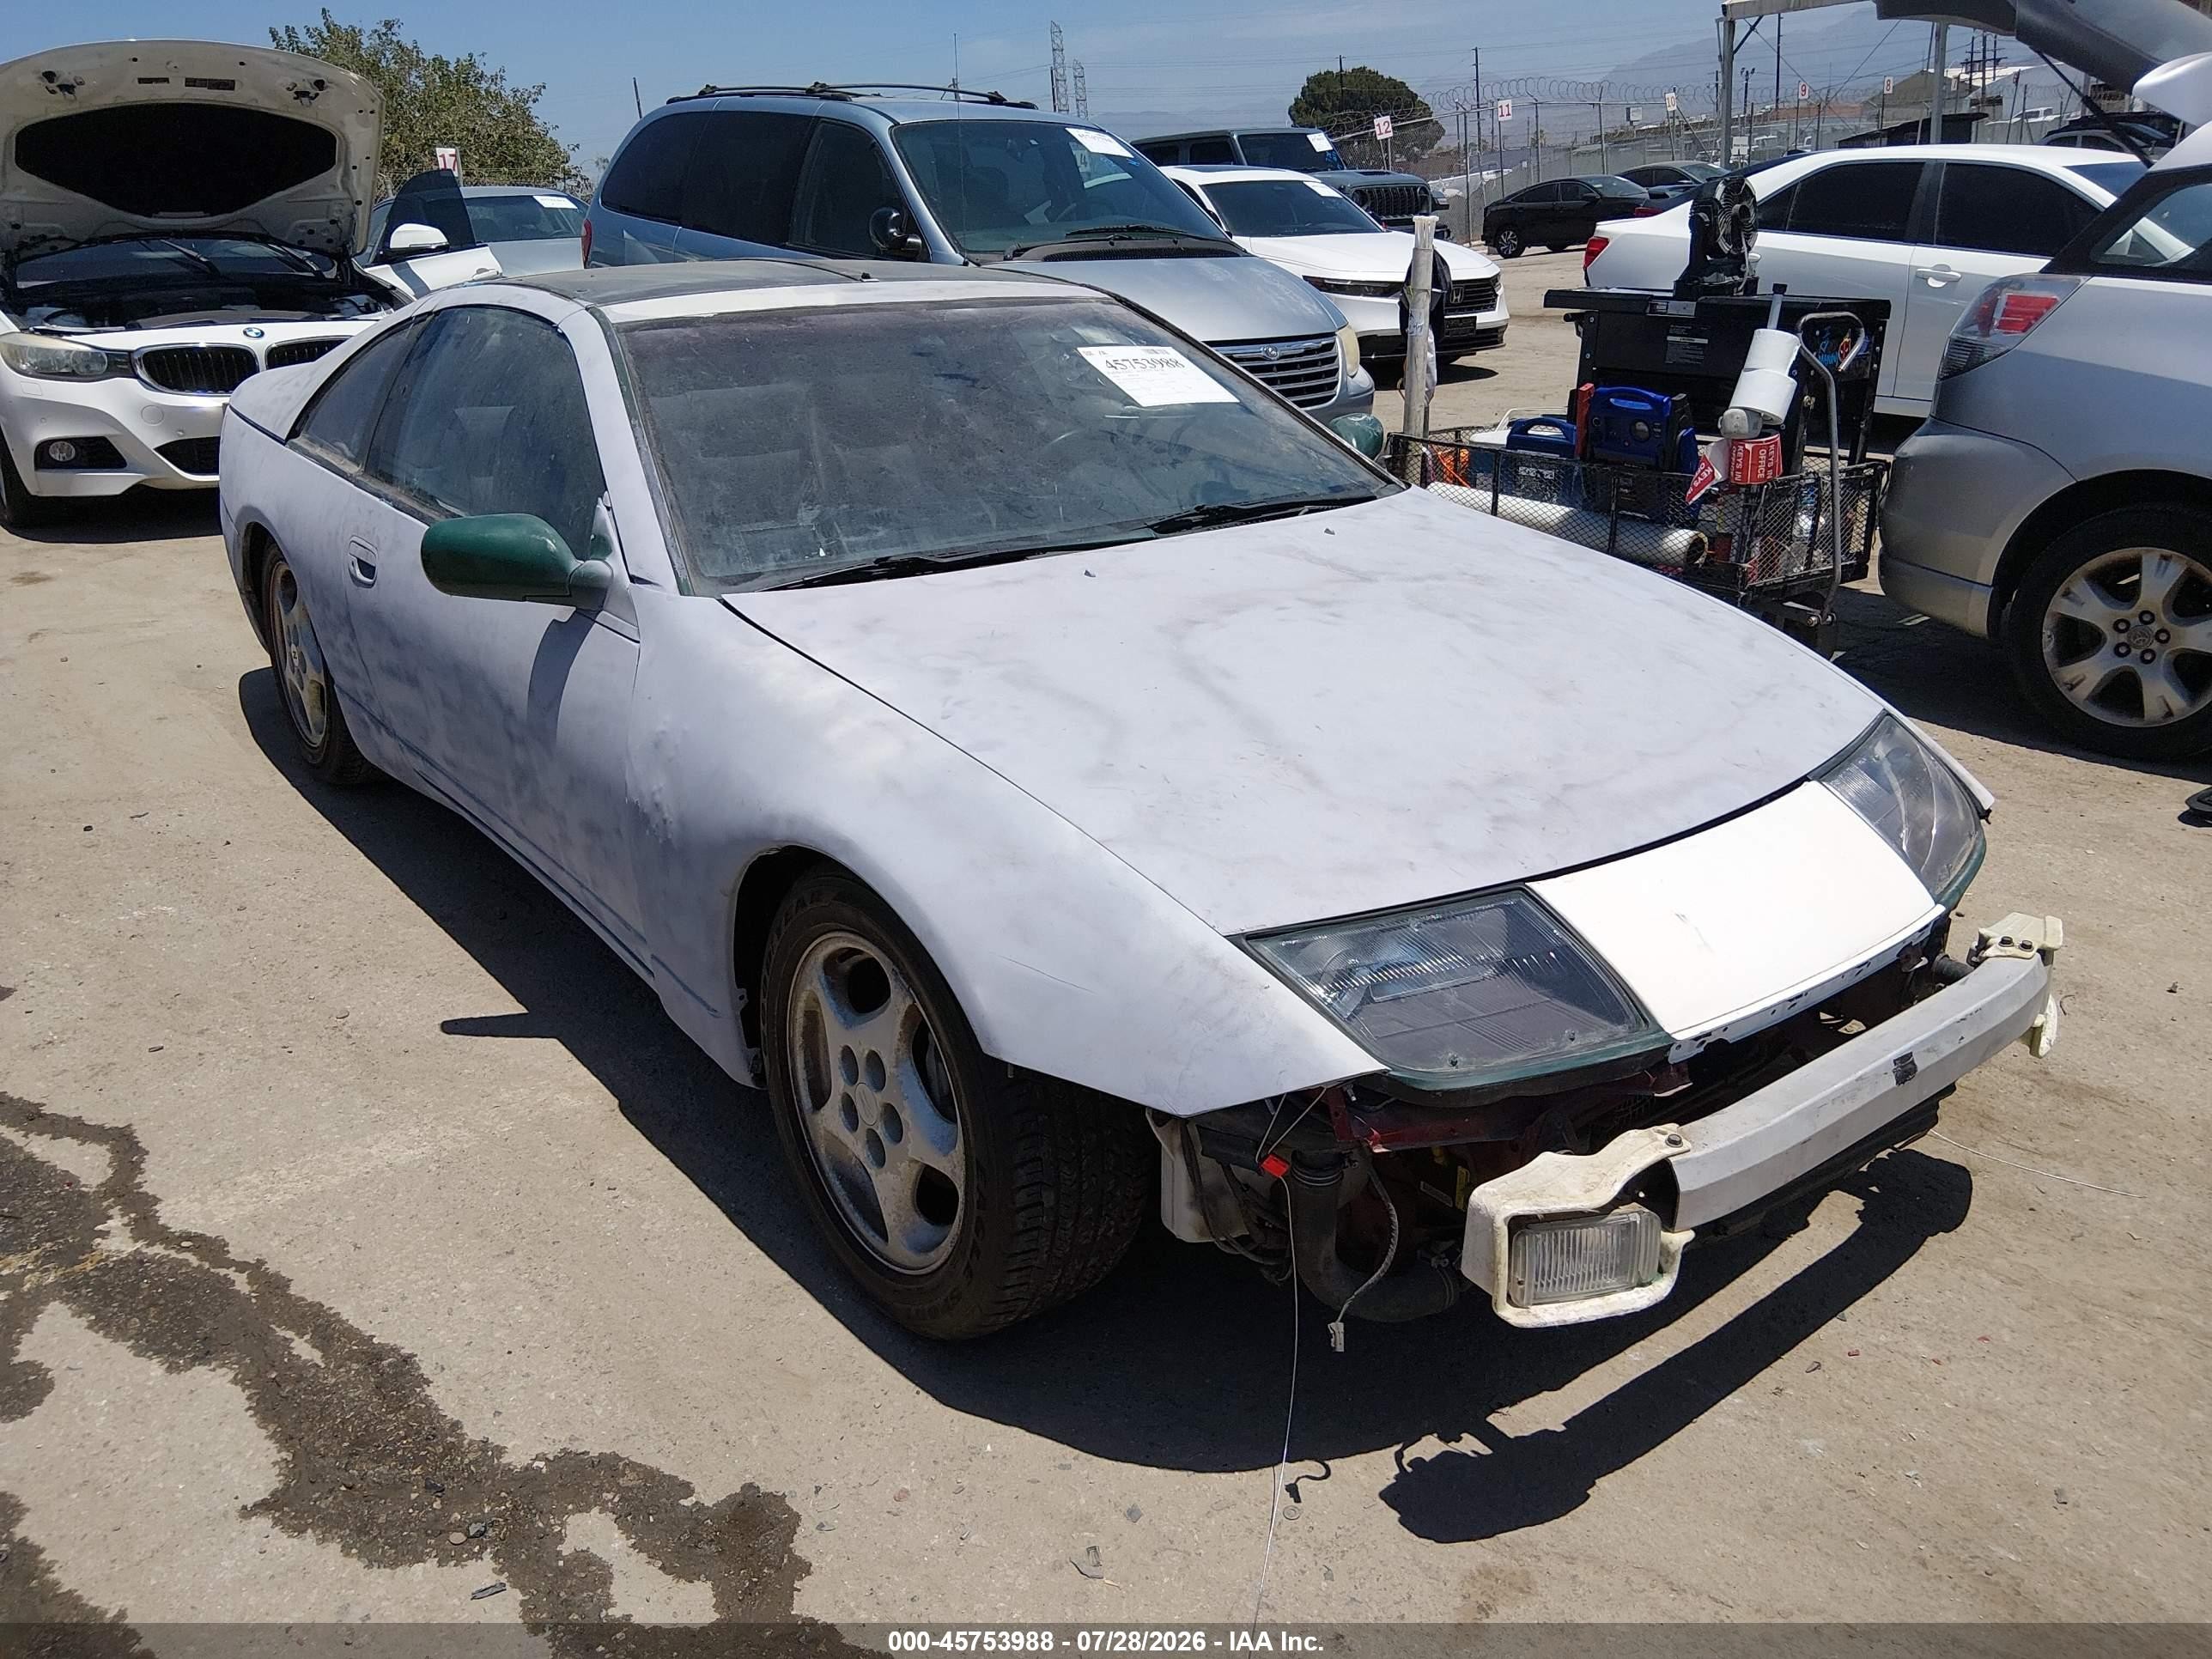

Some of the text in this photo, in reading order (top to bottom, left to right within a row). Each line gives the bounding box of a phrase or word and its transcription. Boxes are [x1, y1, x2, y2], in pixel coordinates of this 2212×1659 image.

[1801, 84, 1807, 96] 9
[1886, 78, 1892, 92] 8
[1666, 96, 1675, 107] 10
[1498, 103, 1512, 118] 11
[1375, 120, 1392, 137] 12
[438, 153, 457, 171] 17
[1104, 357, 1186, 371] 45753988
[1734, 445, 1744, 482] KEYS IN
[1758, 449, 1766, 479] OFFICE
[1692, 466, 1713, 487] KEYS
[1766, 469, 1773, 479] IN
